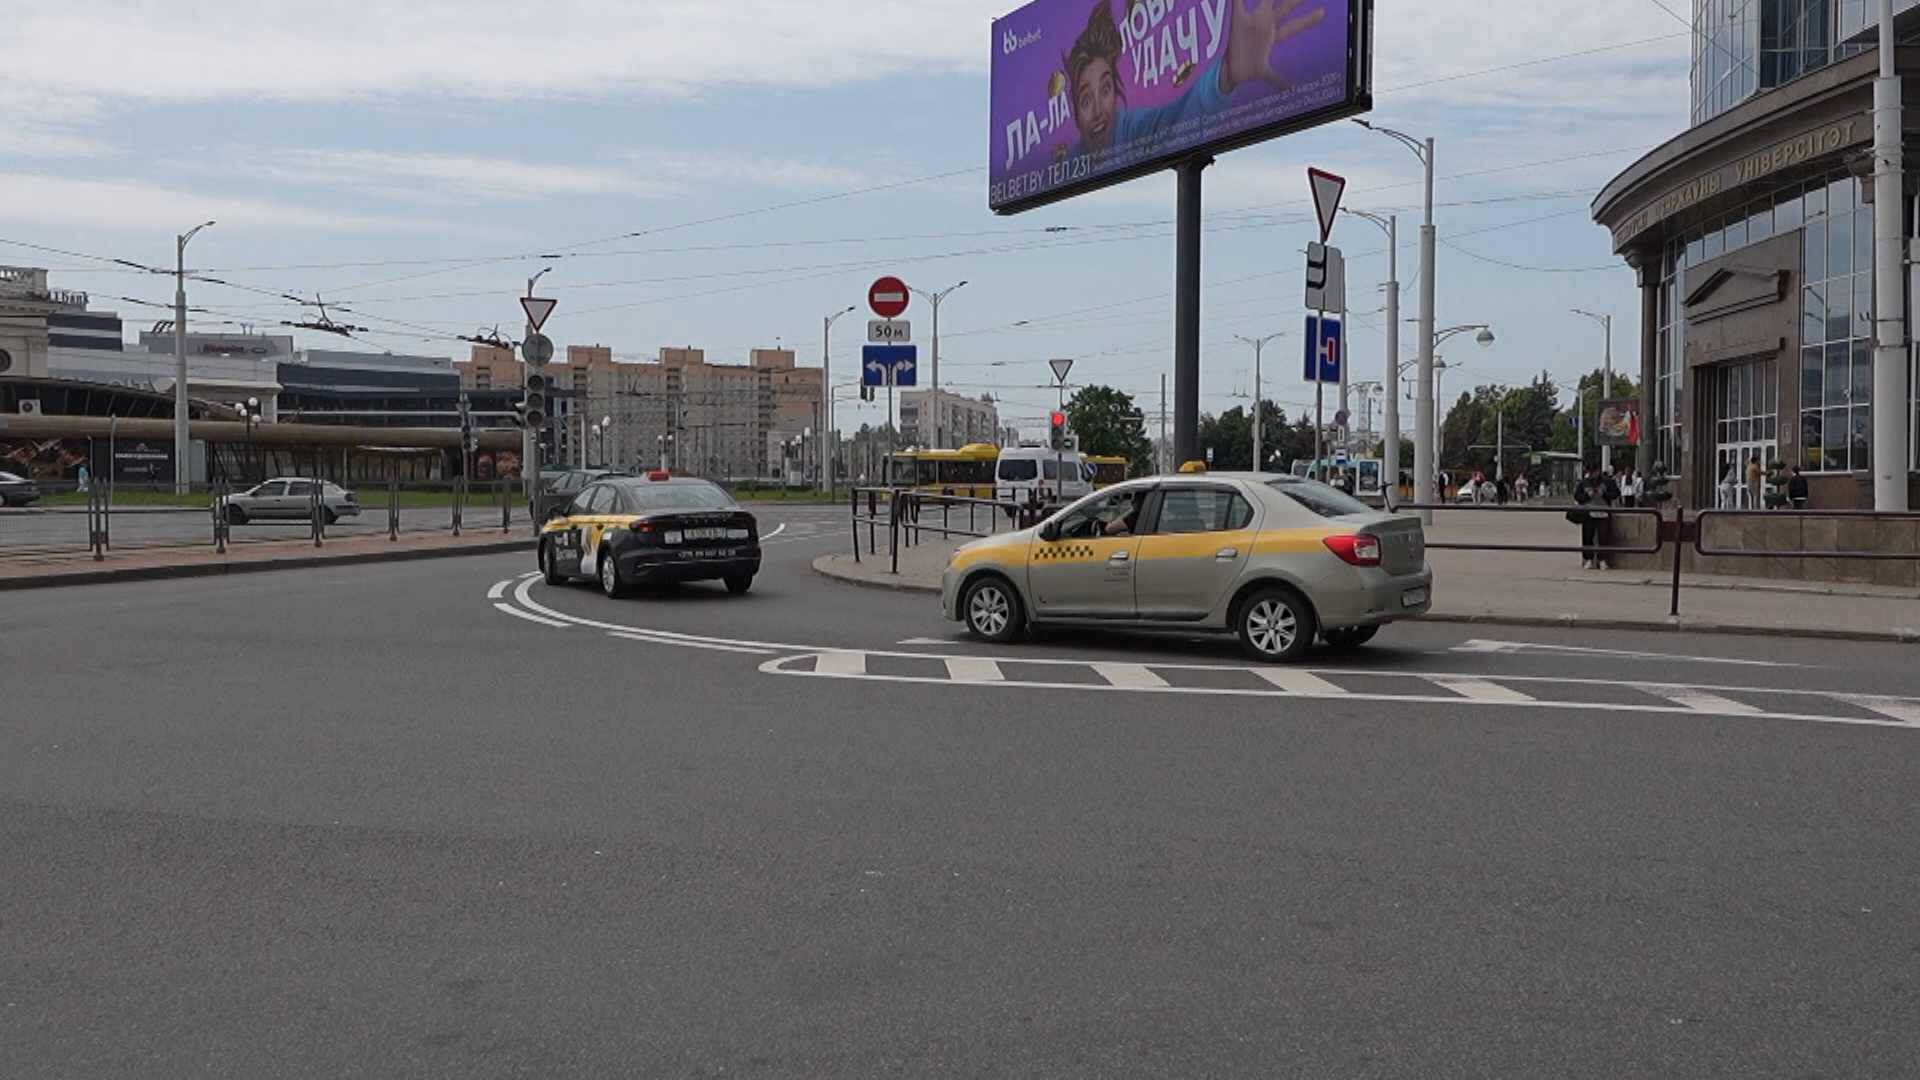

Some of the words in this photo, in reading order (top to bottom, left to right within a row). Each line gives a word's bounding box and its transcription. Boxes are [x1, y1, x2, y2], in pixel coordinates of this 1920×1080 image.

[1120, 0, 1175, 54] ЛОВ
[1131, 0, 1226, 88] УДАЧУ
[1005, 91, 1071, 171] ЛА-ЛА
